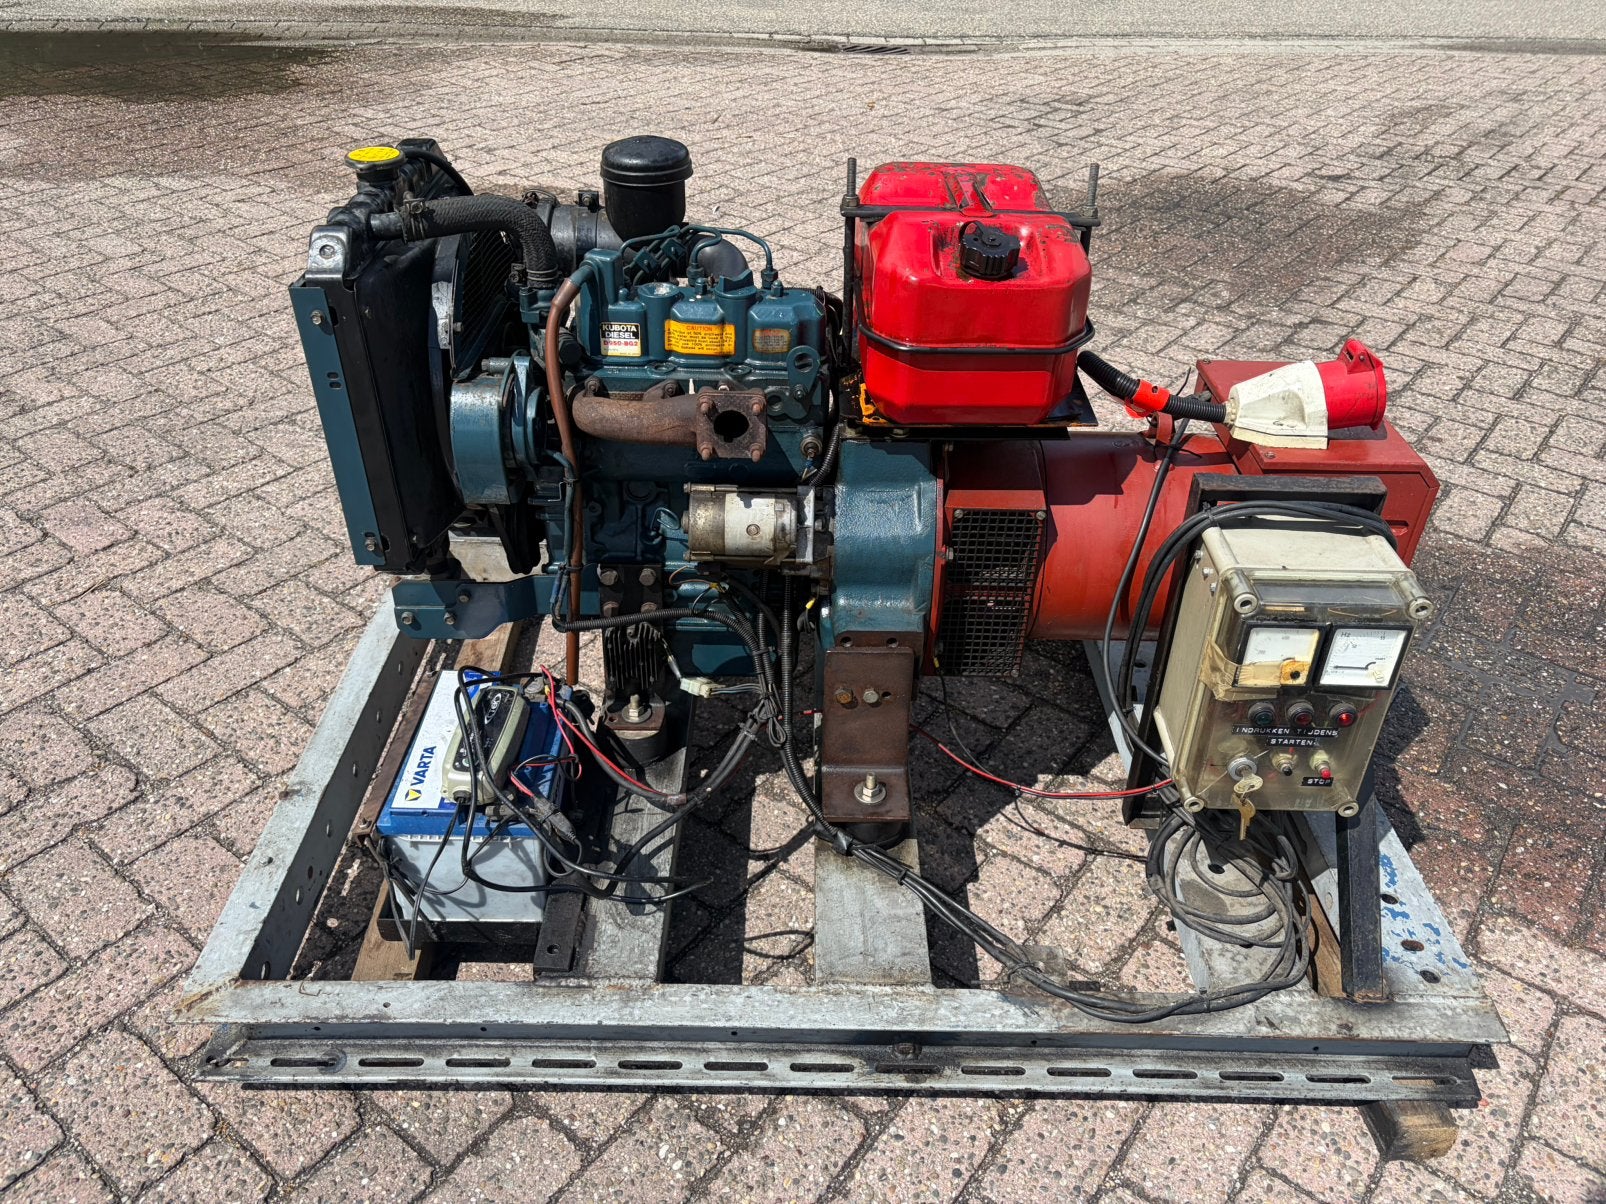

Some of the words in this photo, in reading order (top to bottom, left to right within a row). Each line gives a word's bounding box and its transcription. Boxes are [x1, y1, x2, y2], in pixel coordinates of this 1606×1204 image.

[602, 324, 637, 332] KUBOTA
[605, 331, 636, 339] DIESEL
[1236, 726, 1290, 735] INDRUKKEN
[1296, 728, 1338, 736] TIJDENS
[410, 746, 437, 787] VARTA
